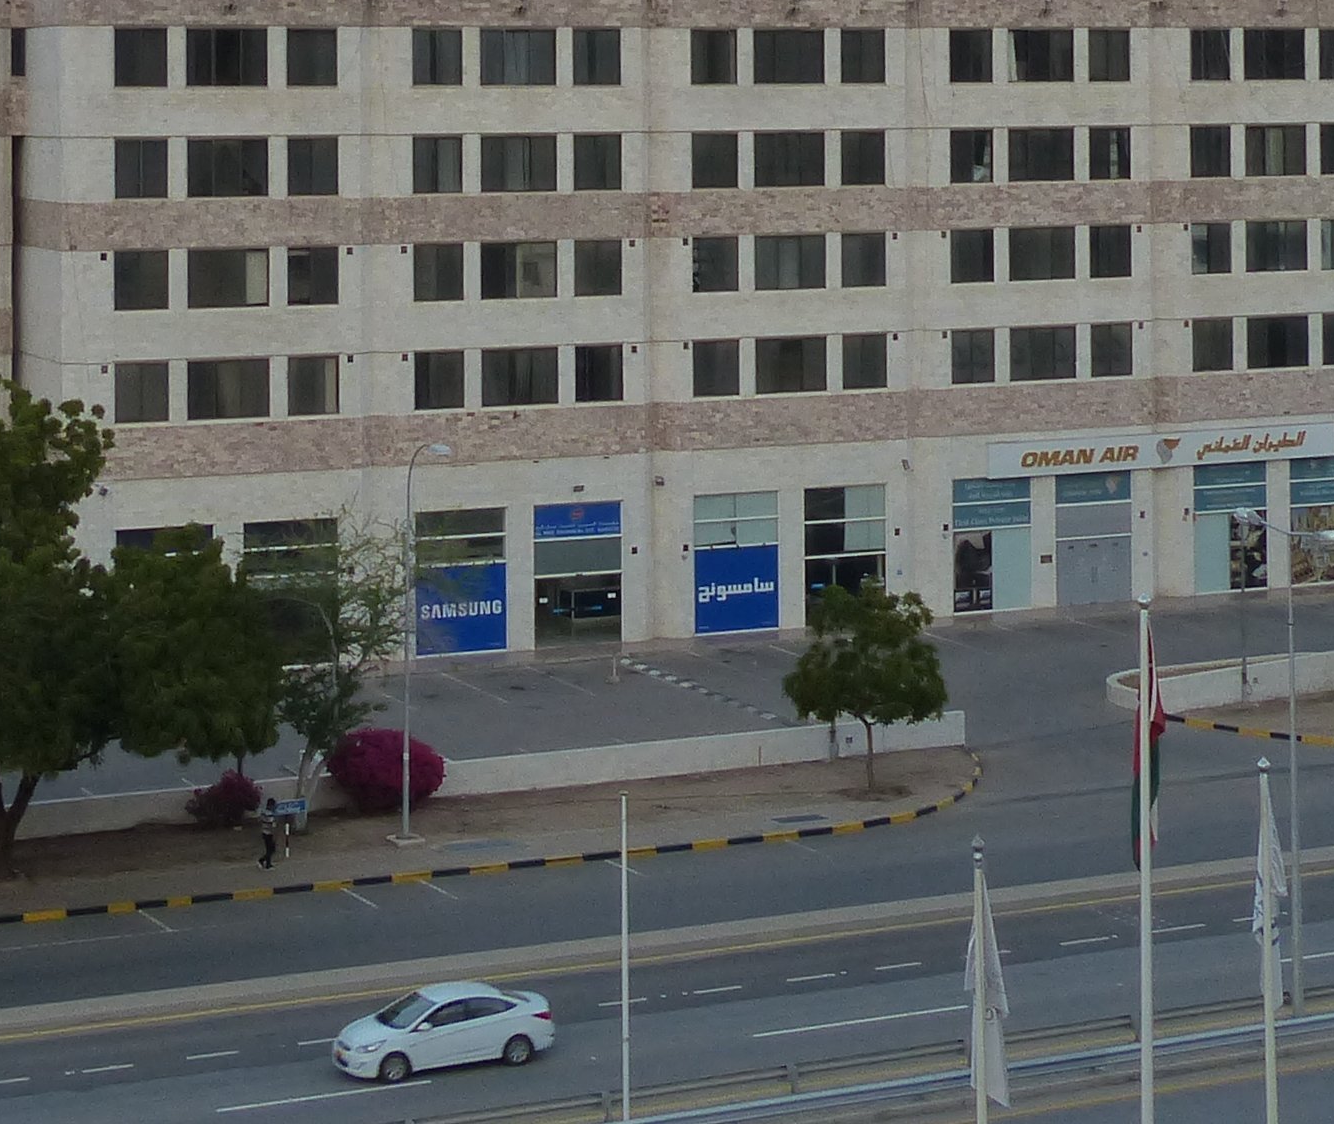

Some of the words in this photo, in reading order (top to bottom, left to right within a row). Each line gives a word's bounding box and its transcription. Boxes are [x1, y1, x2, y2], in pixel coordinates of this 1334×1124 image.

[1252, 430, 1307, 453] الطيران
[1020, 447, 1096, 468] OMAN
[1098, 445, 1140, 463] AIR
[698, 577, 775, 603] سامسونج
[420, 599, 503, 620] SAMSUNG
